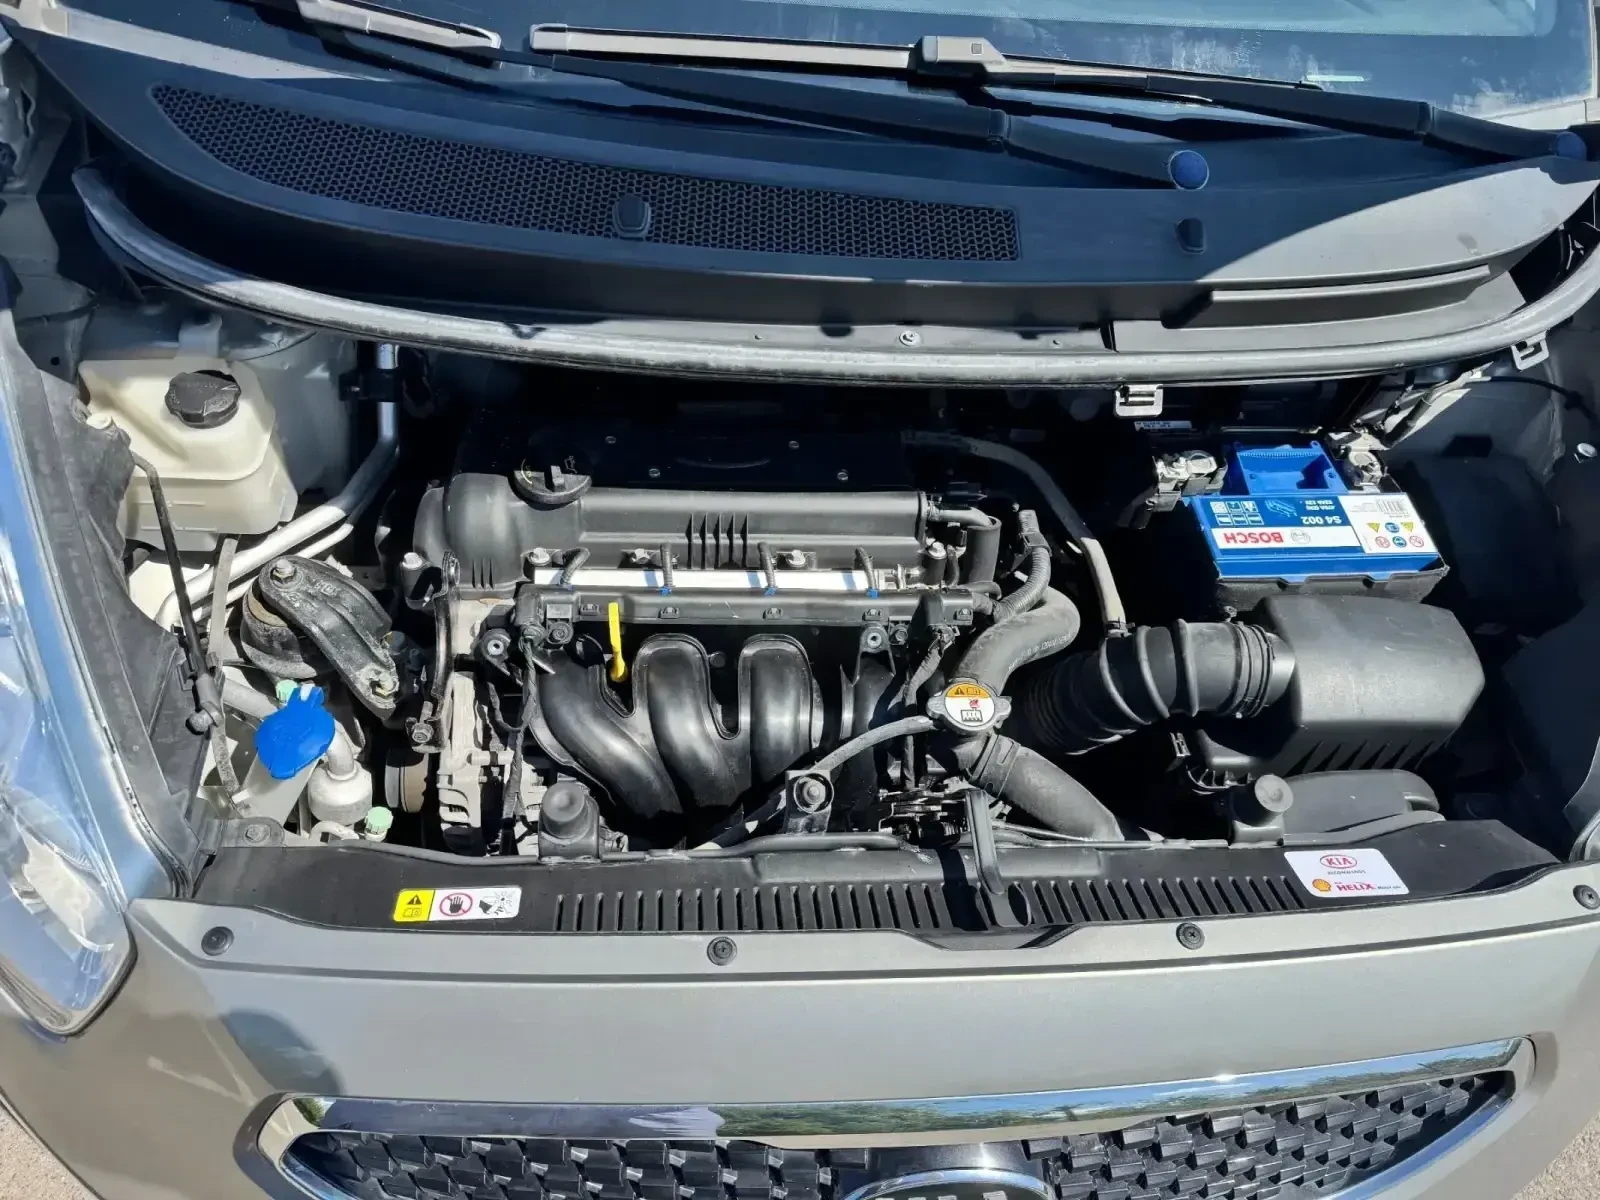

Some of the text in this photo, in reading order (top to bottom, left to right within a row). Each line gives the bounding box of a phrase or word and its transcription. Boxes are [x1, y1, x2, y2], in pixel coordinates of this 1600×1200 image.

[1301, 515, 1342, 525] S4 002
[1223, 531, 1284, 543] BOSCH
[1326, 857, 1352, 866] KIA
[1336, 883, 1376, 891] HELIX
